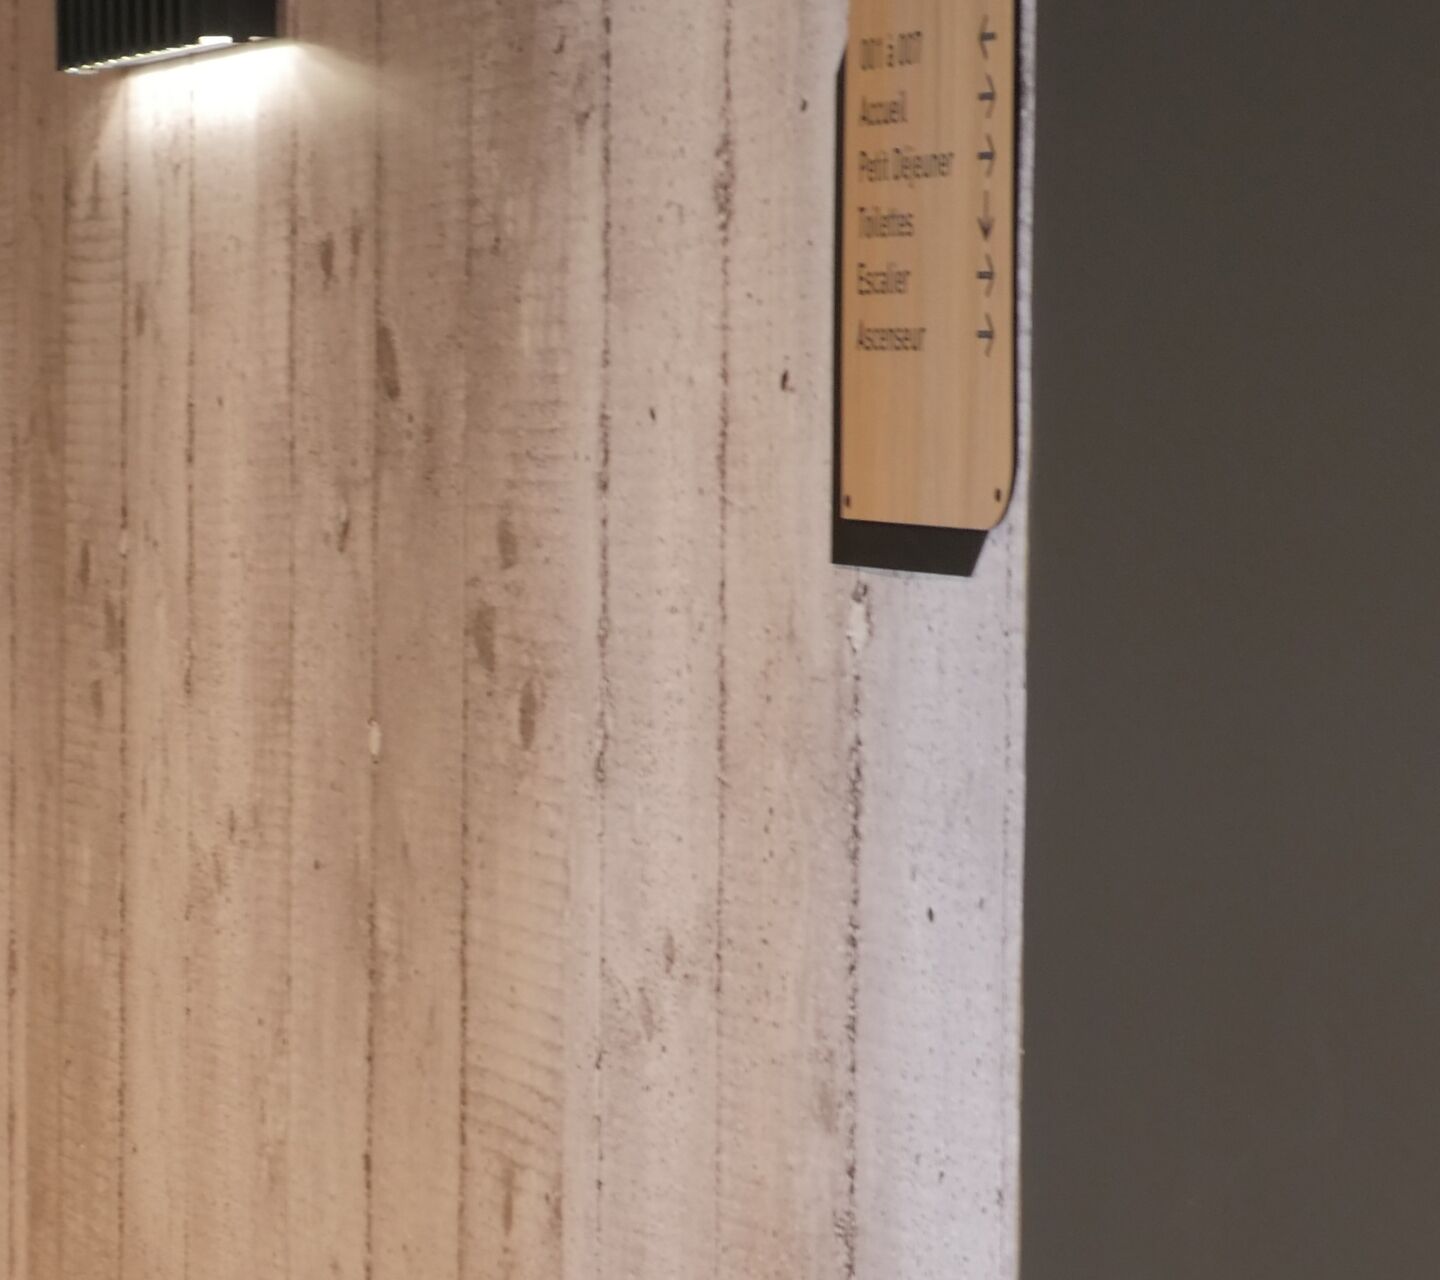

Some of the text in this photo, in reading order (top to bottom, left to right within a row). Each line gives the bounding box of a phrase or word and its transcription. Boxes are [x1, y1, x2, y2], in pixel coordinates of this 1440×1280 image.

[859, 90, 908, 126] Accueil
[858, 145, 955, 189] Petit Déjeuner
[857, 205, 915, 238] Toilettes
[856, 261, 911, 296] Escalier
[856, 319, 927, 352] Ascenseur
